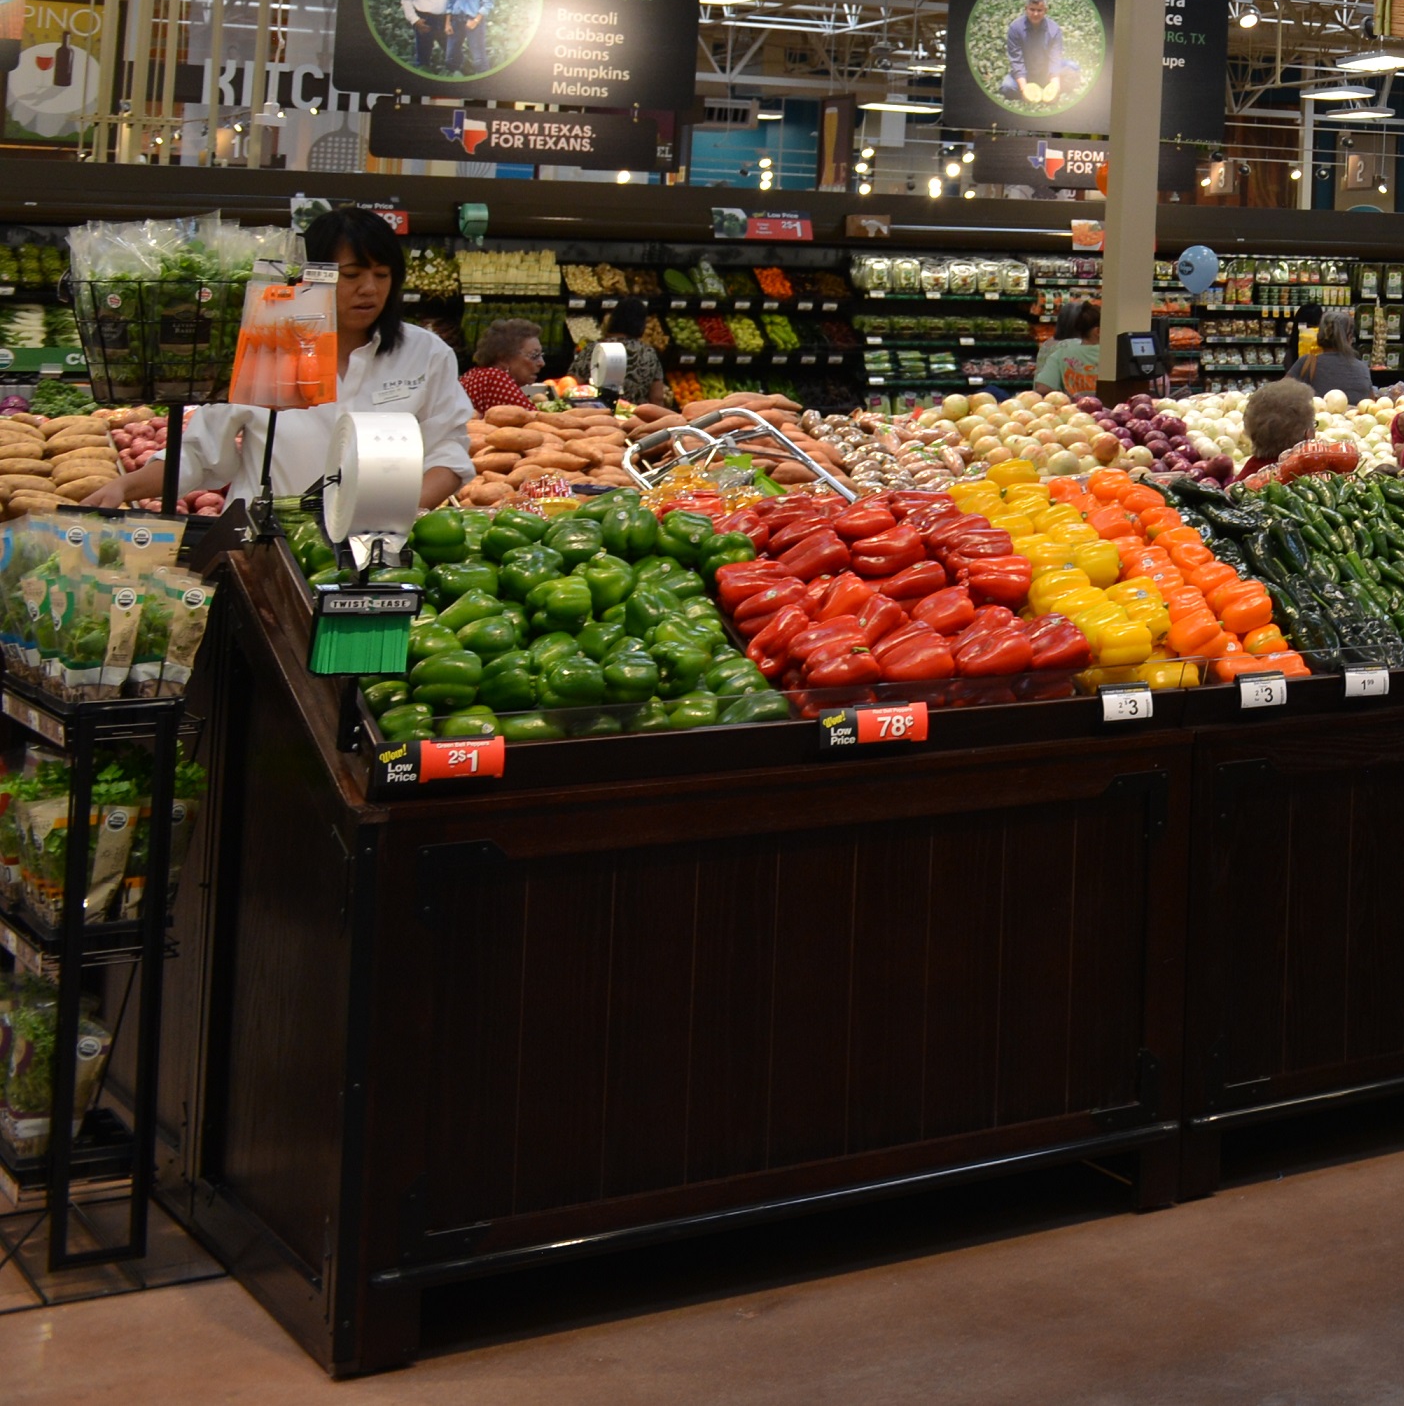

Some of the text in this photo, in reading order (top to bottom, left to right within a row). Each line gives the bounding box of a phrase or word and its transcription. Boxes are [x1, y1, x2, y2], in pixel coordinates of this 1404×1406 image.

[557, 8, 618, 25] Broccoli
[555, 27, 624, 46] Cabbage
[1190, 32, 1206, 45] TX
[554, 45, 610, 61] Onions
[553, 63, 630, 81] Pumpkins
[552, 81, 609, 98] Melons
[492, 121, 597, 138] FROM TEXAS.
[490, 134, 594, 152] FOR TEXANS.
[1067, 150, 1104, 162] FROM
[1067, 162, 1093, 174] FOR
[1356, 160, 1365, 183] 2
[1217, 167, 1225, 188] 3
[830, 727, 852, 737] Low
[830, 736, 856, 746] Price
[379, 743, 407, 764] Wow!
[387, 762, 413, 773] Low
[387, 772, 417, 783] Price
